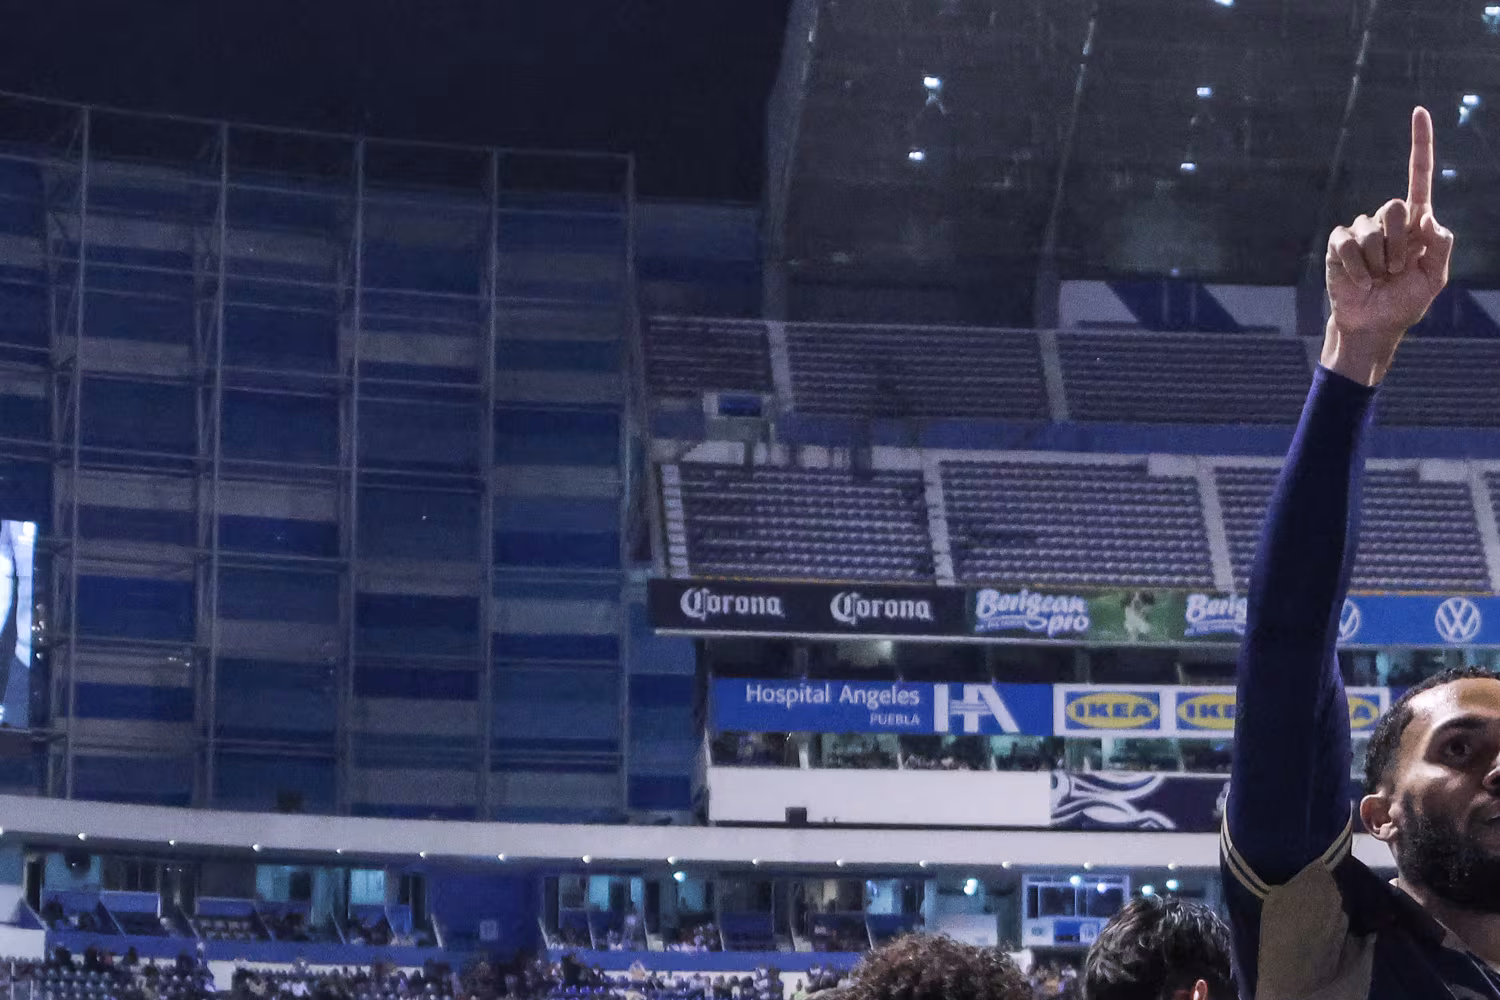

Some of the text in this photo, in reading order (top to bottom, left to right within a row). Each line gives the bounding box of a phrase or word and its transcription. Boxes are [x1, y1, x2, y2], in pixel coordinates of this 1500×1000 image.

[680, 587, 785, 621] Corona
[830, 591, 934, 624] Corona
[745, 684, 920, 710] Hospital Angeles
[869, 713, 920, 726] PUEBLA
[1075, 702, 1151, 718] IKEA
[1185, 702, 1236, 718] IKE
